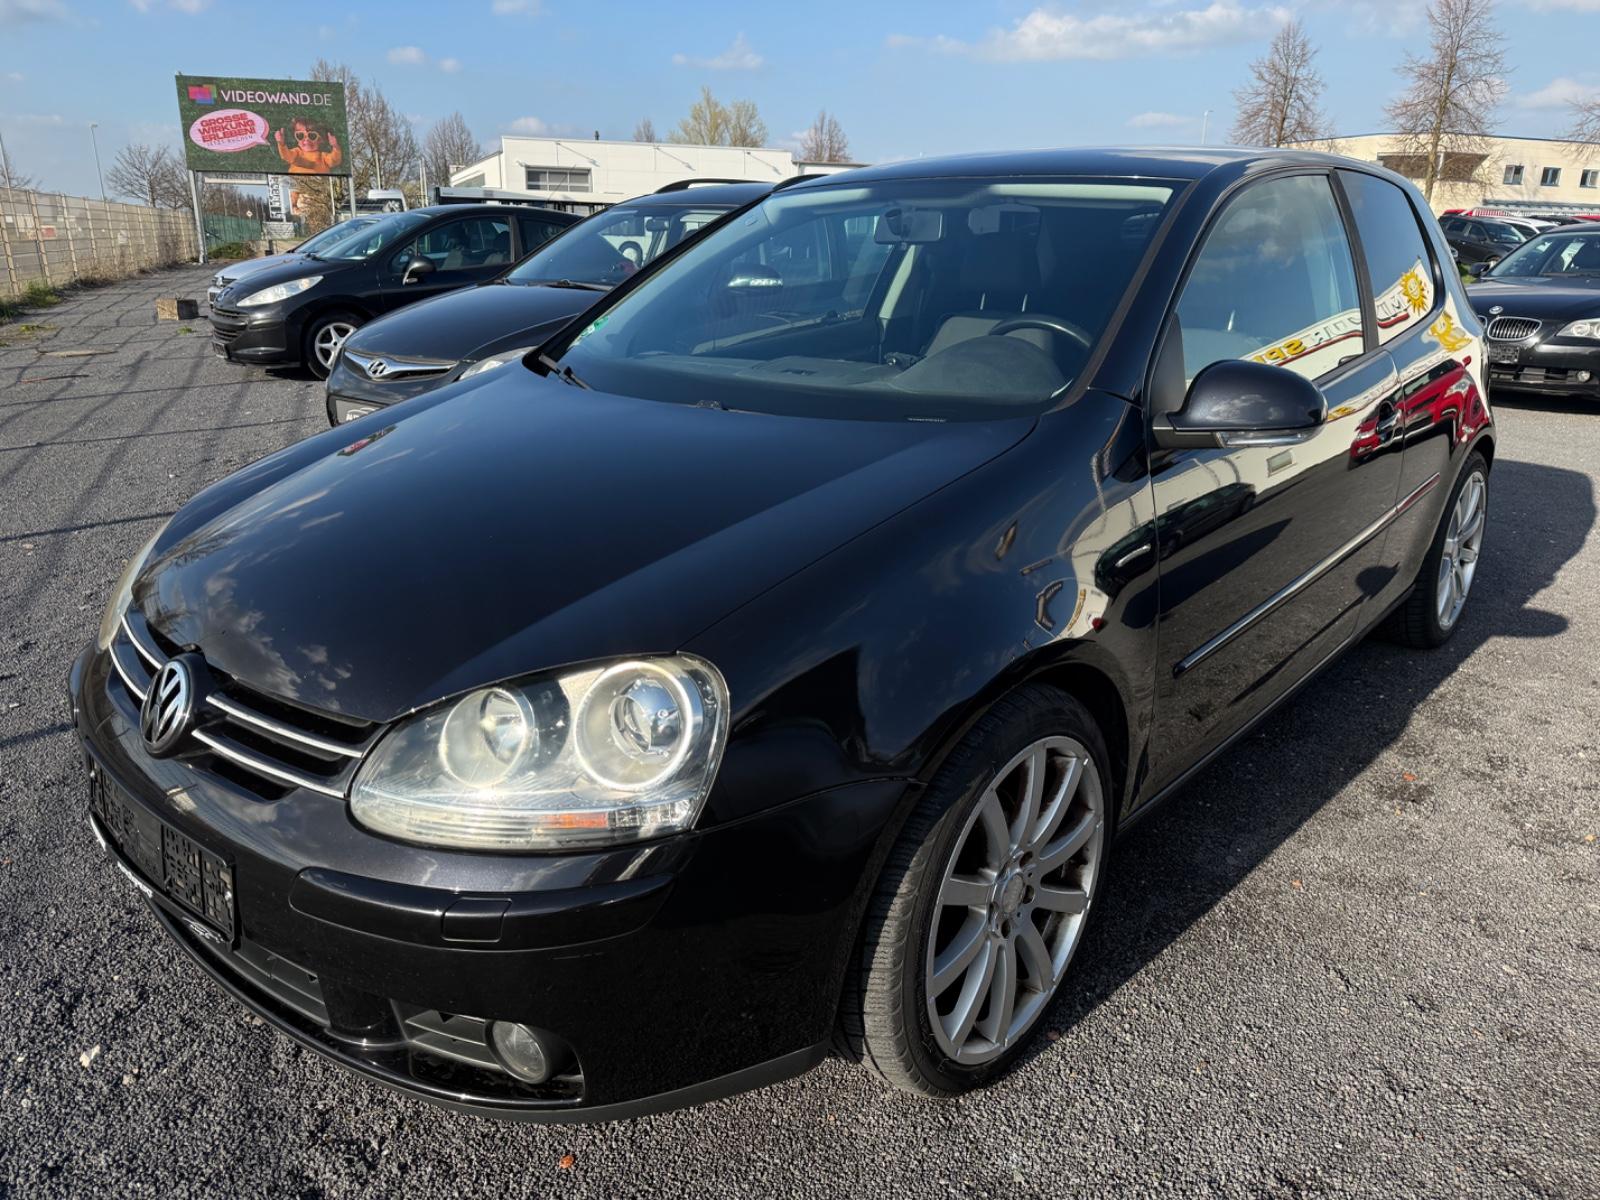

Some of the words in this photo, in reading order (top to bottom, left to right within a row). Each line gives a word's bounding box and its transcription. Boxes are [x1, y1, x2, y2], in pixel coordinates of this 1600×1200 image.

[220, 90, 332, 106] VIDEOWAND.DE
[198, 120, 256, 135] WIRKUNG
[200, 113, 248, 127] GROSSE
[202, 127, 256, 143] ERLEBEN!
